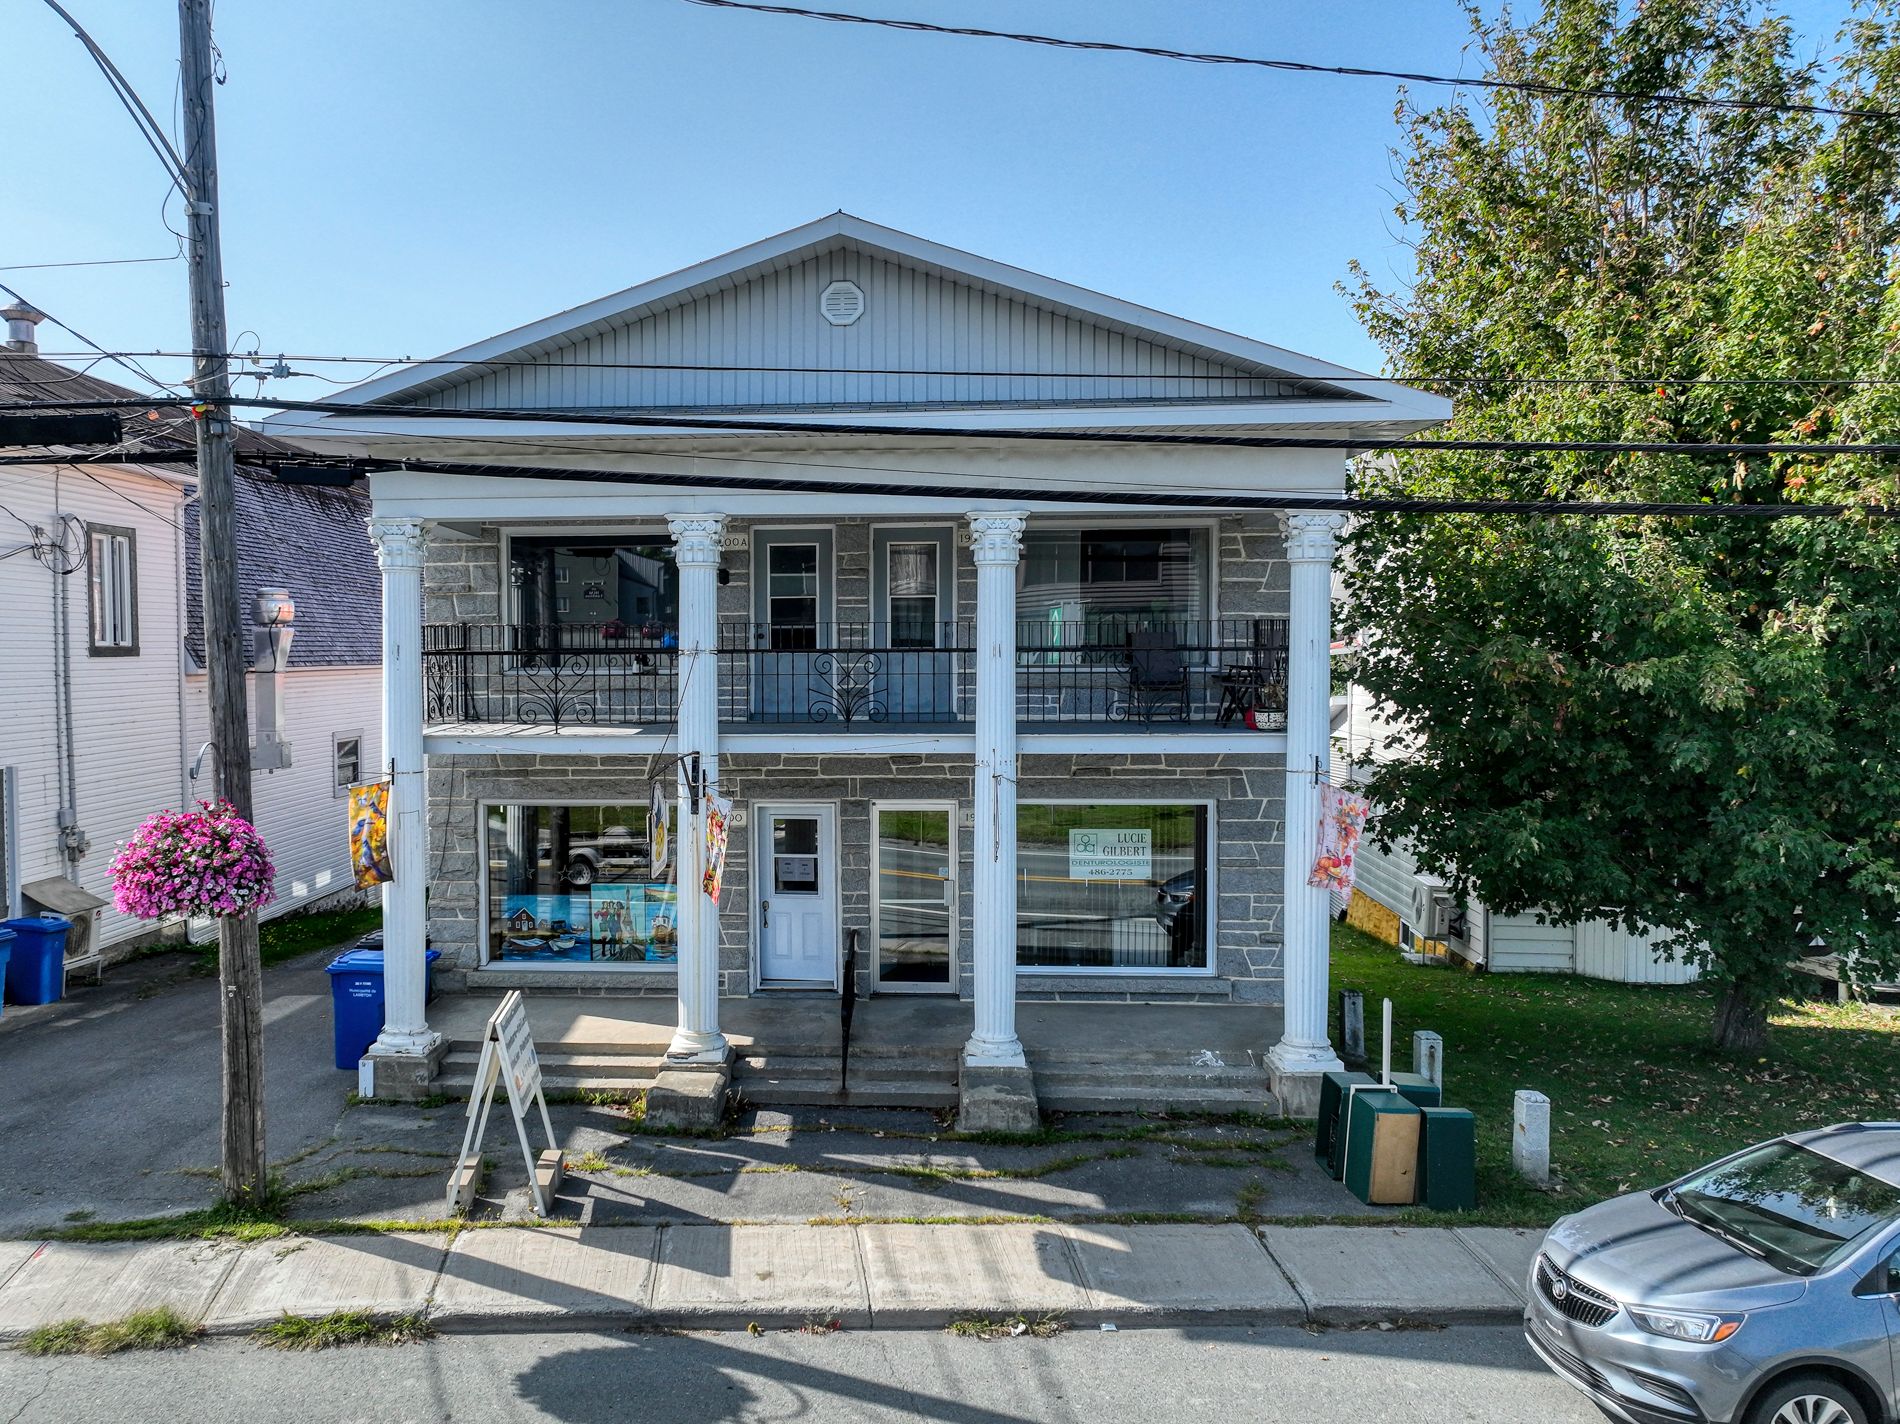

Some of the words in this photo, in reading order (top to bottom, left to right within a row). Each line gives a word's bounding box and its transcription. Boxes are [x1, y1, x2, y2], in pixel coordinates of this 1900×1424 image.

[720, 537, 747, 547] 00A
[960, 534, 971, 543] 19
[1117, 833, 1147, 844] LUCIE
[1102, 846, 1147, 857] GILBERT
[1088, 868, 1133, 876] 486-2775
